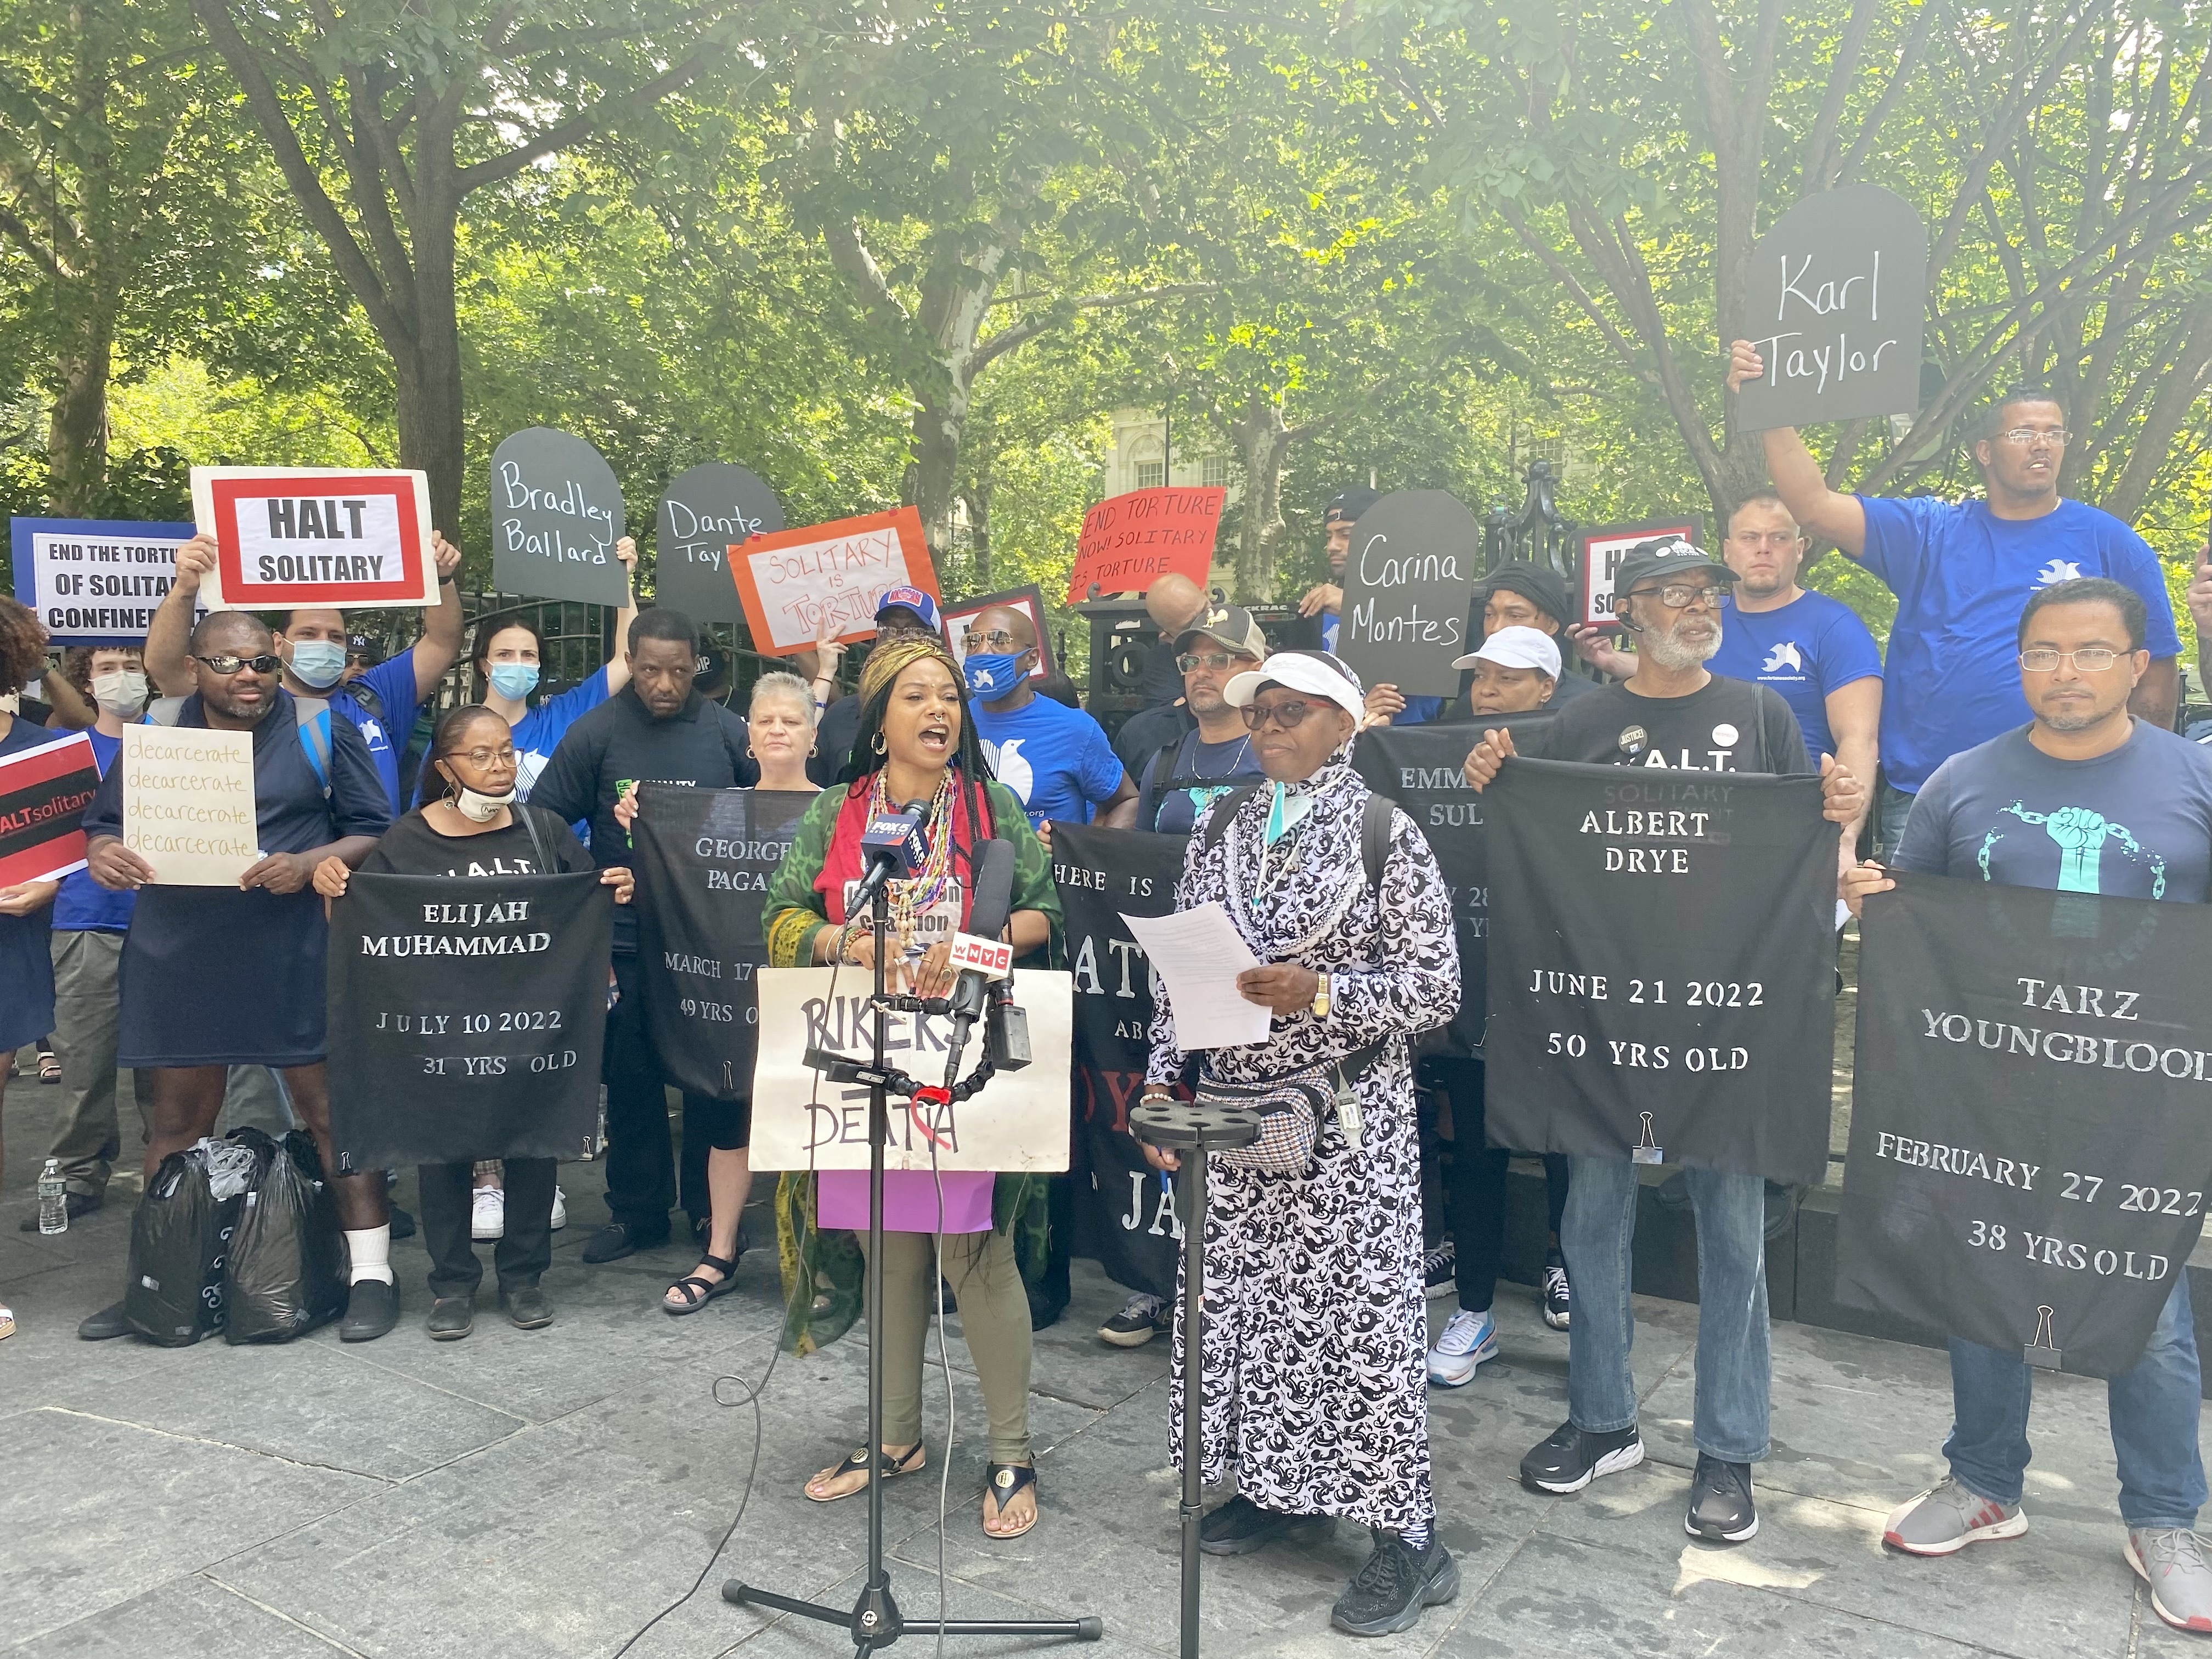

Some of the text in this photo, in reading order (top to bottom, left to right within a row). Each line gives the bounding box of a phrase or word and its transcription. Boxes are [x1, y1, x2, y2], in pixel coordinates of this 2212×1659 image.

[1778, 251, 1879, 320] Karl
[1751, 332, 1897, 394] Taylor
[268, 499, 366, 539] HALT
[500, 461, 613, 546] Bradley
[1084, 494, 1218, 539] END TORTURE
[667, 500, 768, 539] Dante
[49, 544, 83, 561] END
[87, 545, 120, 562] THE
[503, 519, 607, 565] Ballard
[770, 531, 890, 583] SOLITARY
[1079, 529, 1207, 562] NOW! SOLITARY
[258, 555, 383, 582] SOLITARY
[1071, 557, 1172, 592] IS TORTURE.
[1360, 534, 1464, 588] Carina
[55, 573, 176, 596] OF SOLITA
[829, 574, 843, 588] IS
[783, 578, 902, 634] TORTUR
[1351, 597, 1459, 646] Montes
[128, 735, 250, 764] decarcerate
[1621, 729, 1644, 745] JUSTICE!
[128, 767, 247, 792] decarcerate
[1400, 768, 1472, 789] EMM
[128, 797, 251, 824] decarcerate
[1579, 810, 1709, 837] ALBERT
[127, 827, 256, 856] decarcerate
[1605, 847, 1689, 873] DRYE
[1054, 864, 1106, 890] HERE
[1129, 876, 1152, 897] IS
[423, 901, 528, 928] ELIJAH
[361, 932, 551, 957] MUHAMMAD
[955, 944, 1006, 965] WNYC
[664, 951, 752, 980] MARCH 17
[1530, 969, 1764, 1007] JUNE 21 2022
[2017, 977, 2140, 1020] TARZ
[377, 1010, 562, 1035] JULY 10 2022
[680, 999, 695, 1016] 49
[700, 1001, 732, 1022] YRS
[424, 1050, 577, 1076] 31 YRS OLD
[1547, 1032, 1748, 1073] 50 YRS OLD
[1876, 1131, 2203, 1217] FEBRUARY 27 2022
[1967, 1220, 2169, 1281] 38 YRS OLD
